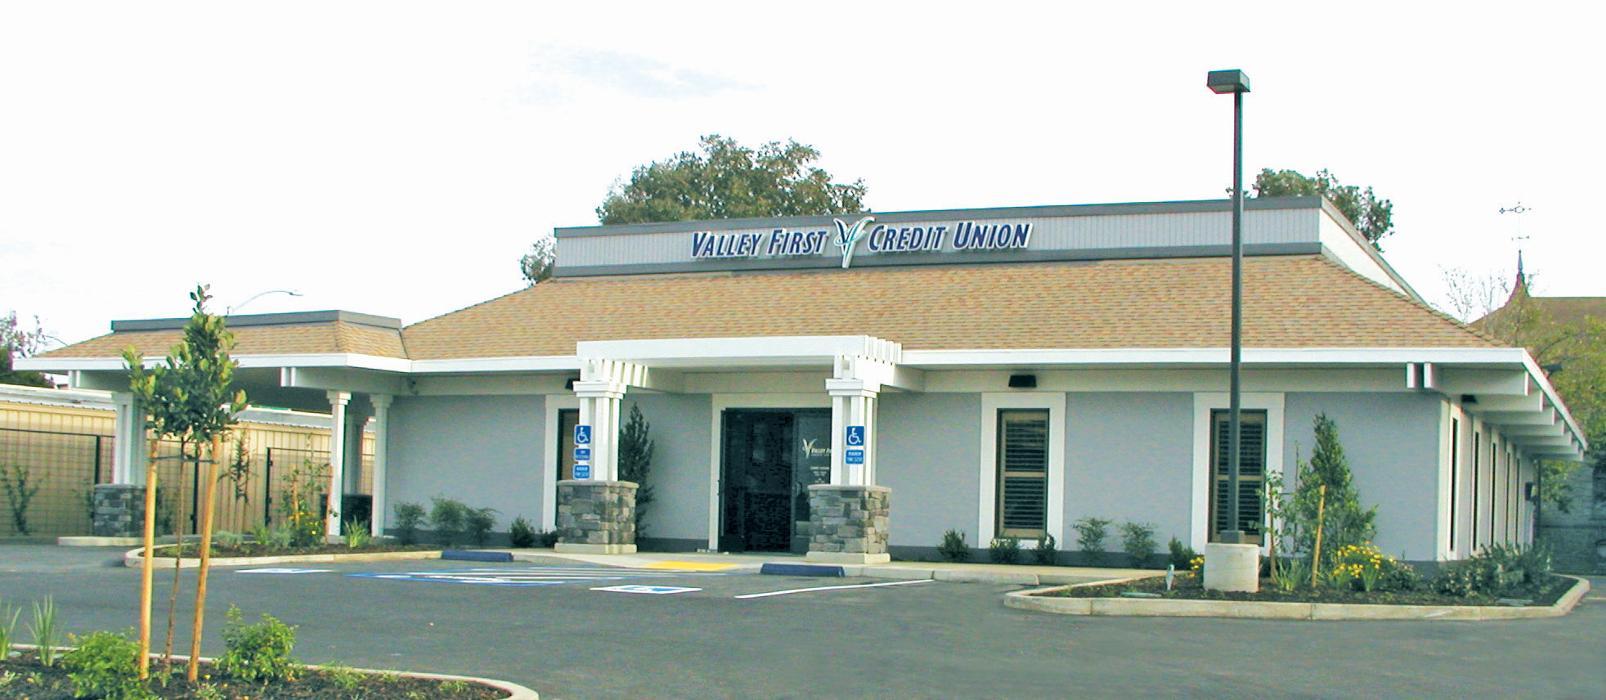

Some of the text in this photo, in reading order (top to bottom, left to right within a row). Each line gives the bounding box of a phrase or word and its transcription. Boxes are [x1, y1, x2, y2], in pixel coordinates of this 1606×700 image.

[691, 220, 1031, 257] VALLEY FIRST CREDIT UNION
